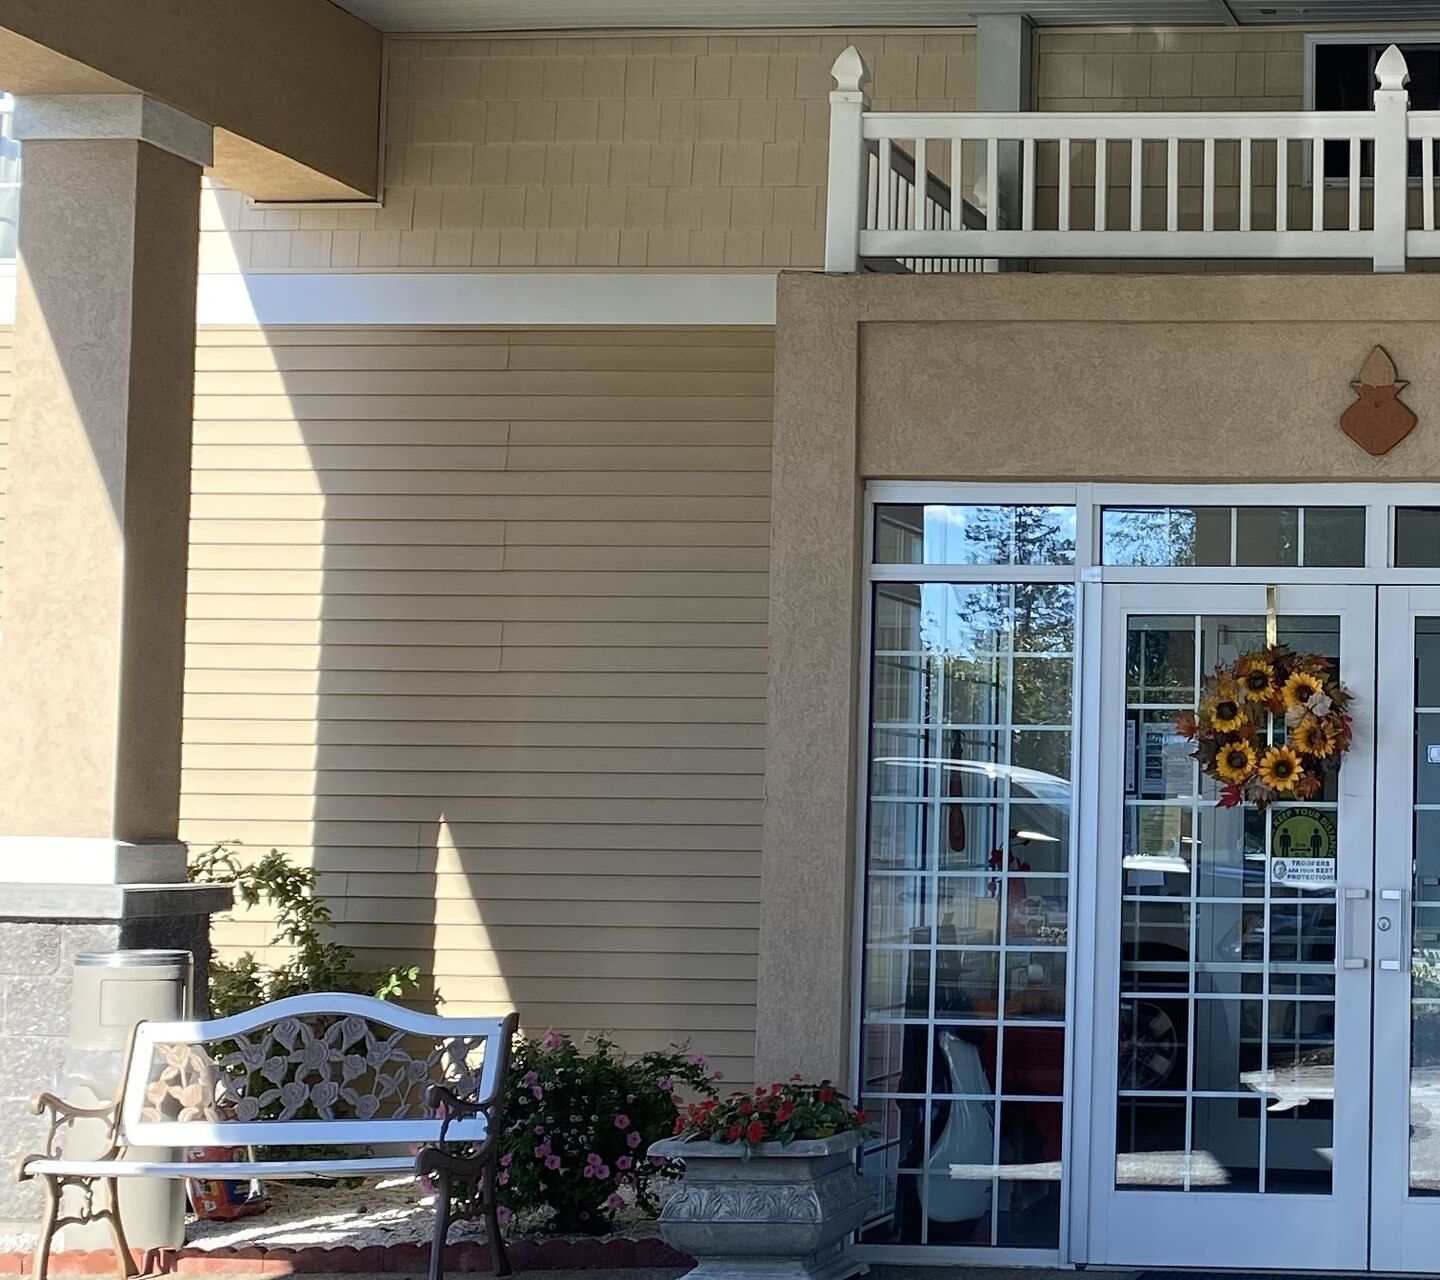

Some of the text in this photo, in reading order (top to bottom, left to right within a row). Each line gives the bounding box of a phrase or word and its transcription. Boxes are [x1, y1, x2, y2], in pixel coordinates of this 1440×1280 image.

[1273, 808, 1336, 857] KEEP YOUR DISTANC
